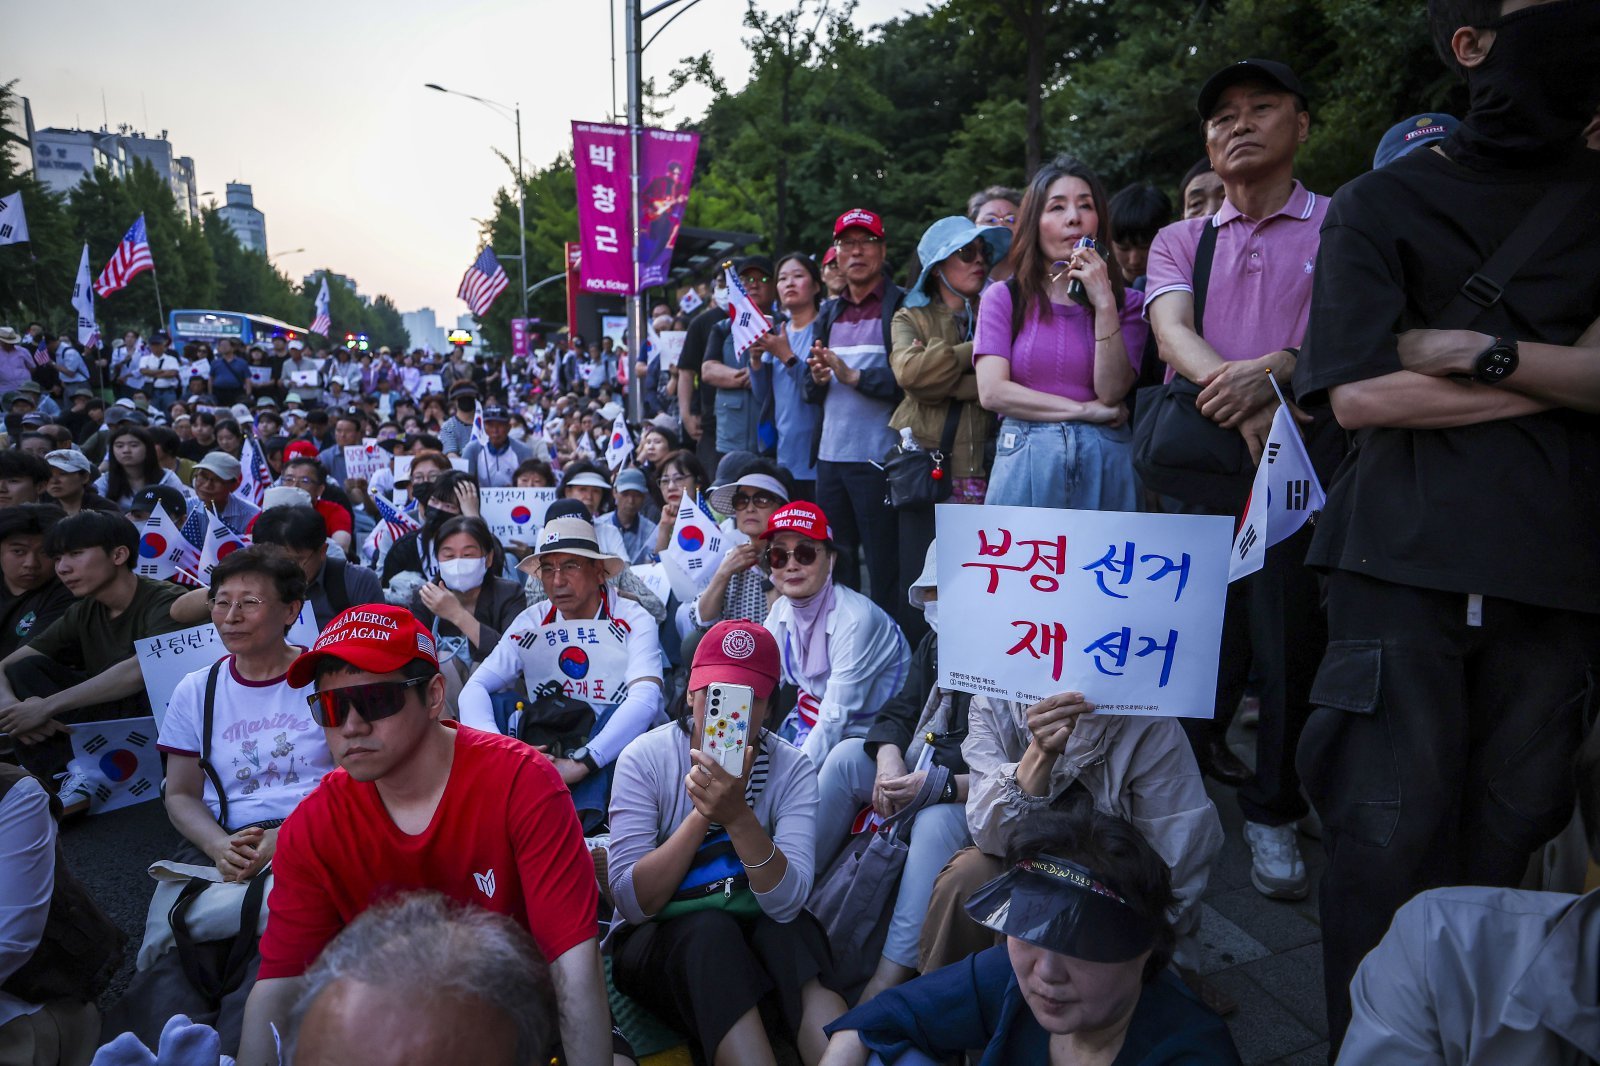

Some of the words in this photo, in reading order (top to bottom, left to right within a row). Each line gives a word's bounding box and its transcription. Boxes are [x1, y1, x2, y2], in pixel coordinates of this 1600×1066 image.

[589, 143, 618, 254] 박창근
[788, 508, 817, 520] AMERICA
[791, 519, 814, 530] AGAIN
[961, 528, 1067, 594] 부정
[1079, 541, 1191, 602] 선거
[343, 611, 399, 631] AMERICA
[315, 629, 350, 652] GREAT
[349, 627, 392, 642] AGAIN
[545, 628, 570, 647] 당일
[577, 627, 600, 644] 투표
[1006, 620, 1068, 682] 재
[1083, 626, 1179, 688] 선거
[949, 671, 970, 682] 대한민국
